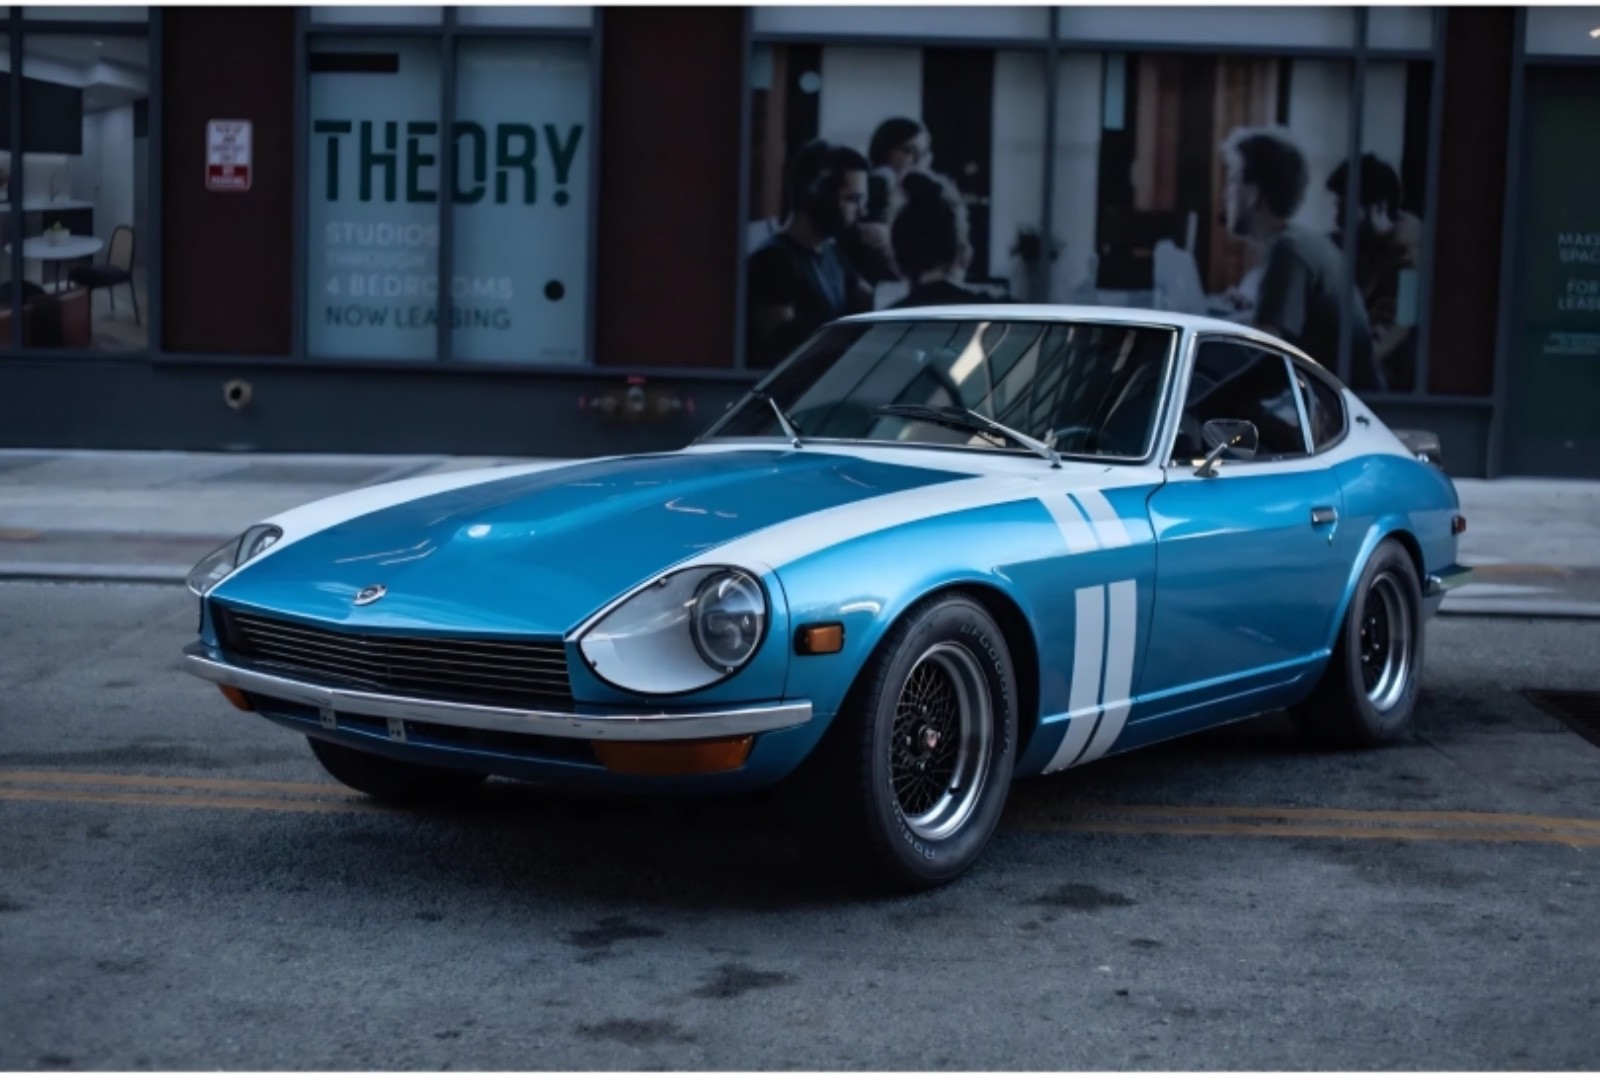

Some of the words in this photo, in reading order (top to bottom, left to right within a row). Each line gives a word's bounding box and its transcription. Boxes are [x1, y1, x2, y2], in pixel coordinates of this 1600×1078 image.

[325, 221, 440, 248] STUDIOS
[325, 277, 339, 296] 4
[349, 274, 514, 300] BEDROOMS
[326, 304, 389, 328] NOW
[394, 305, 511, 331] LEASING
